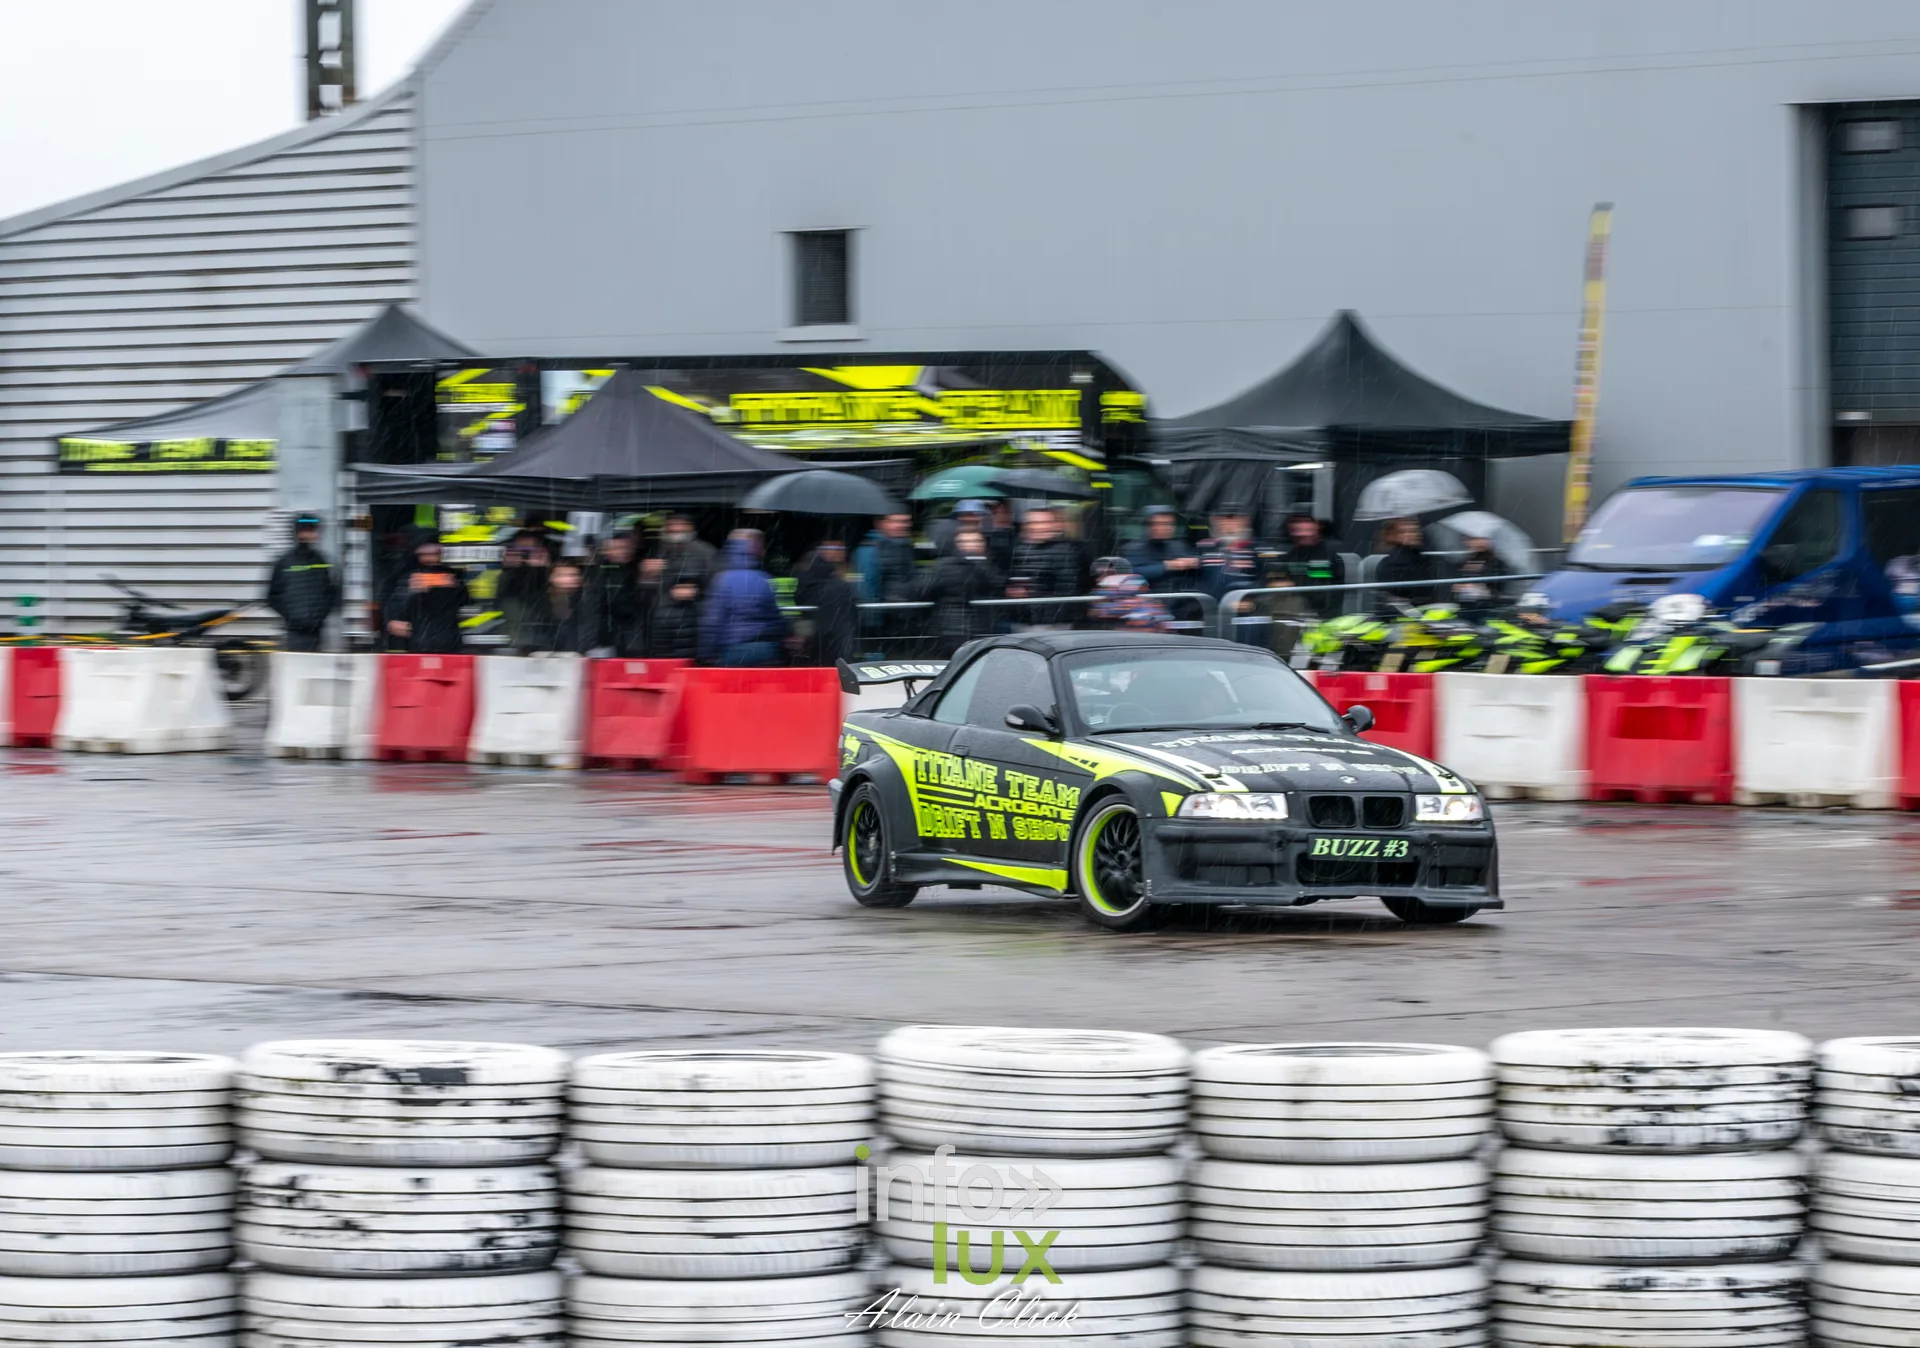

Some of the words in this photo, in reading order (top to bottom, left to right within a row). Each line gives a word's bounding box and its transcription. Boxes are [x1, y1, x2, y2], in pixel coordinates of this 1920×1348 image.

[914, 749, 998, 795] TITANE
[1005, 769, 1081, 809] TEAM
[918, 801, 982, 839] DRIFT
[986, 812, 1007, 839] N
[974, 793, 1077, 821] ACROBATE
[1311, 838, 1380, 857] BUZZ
[1382, 839, 1409, 858] #3
